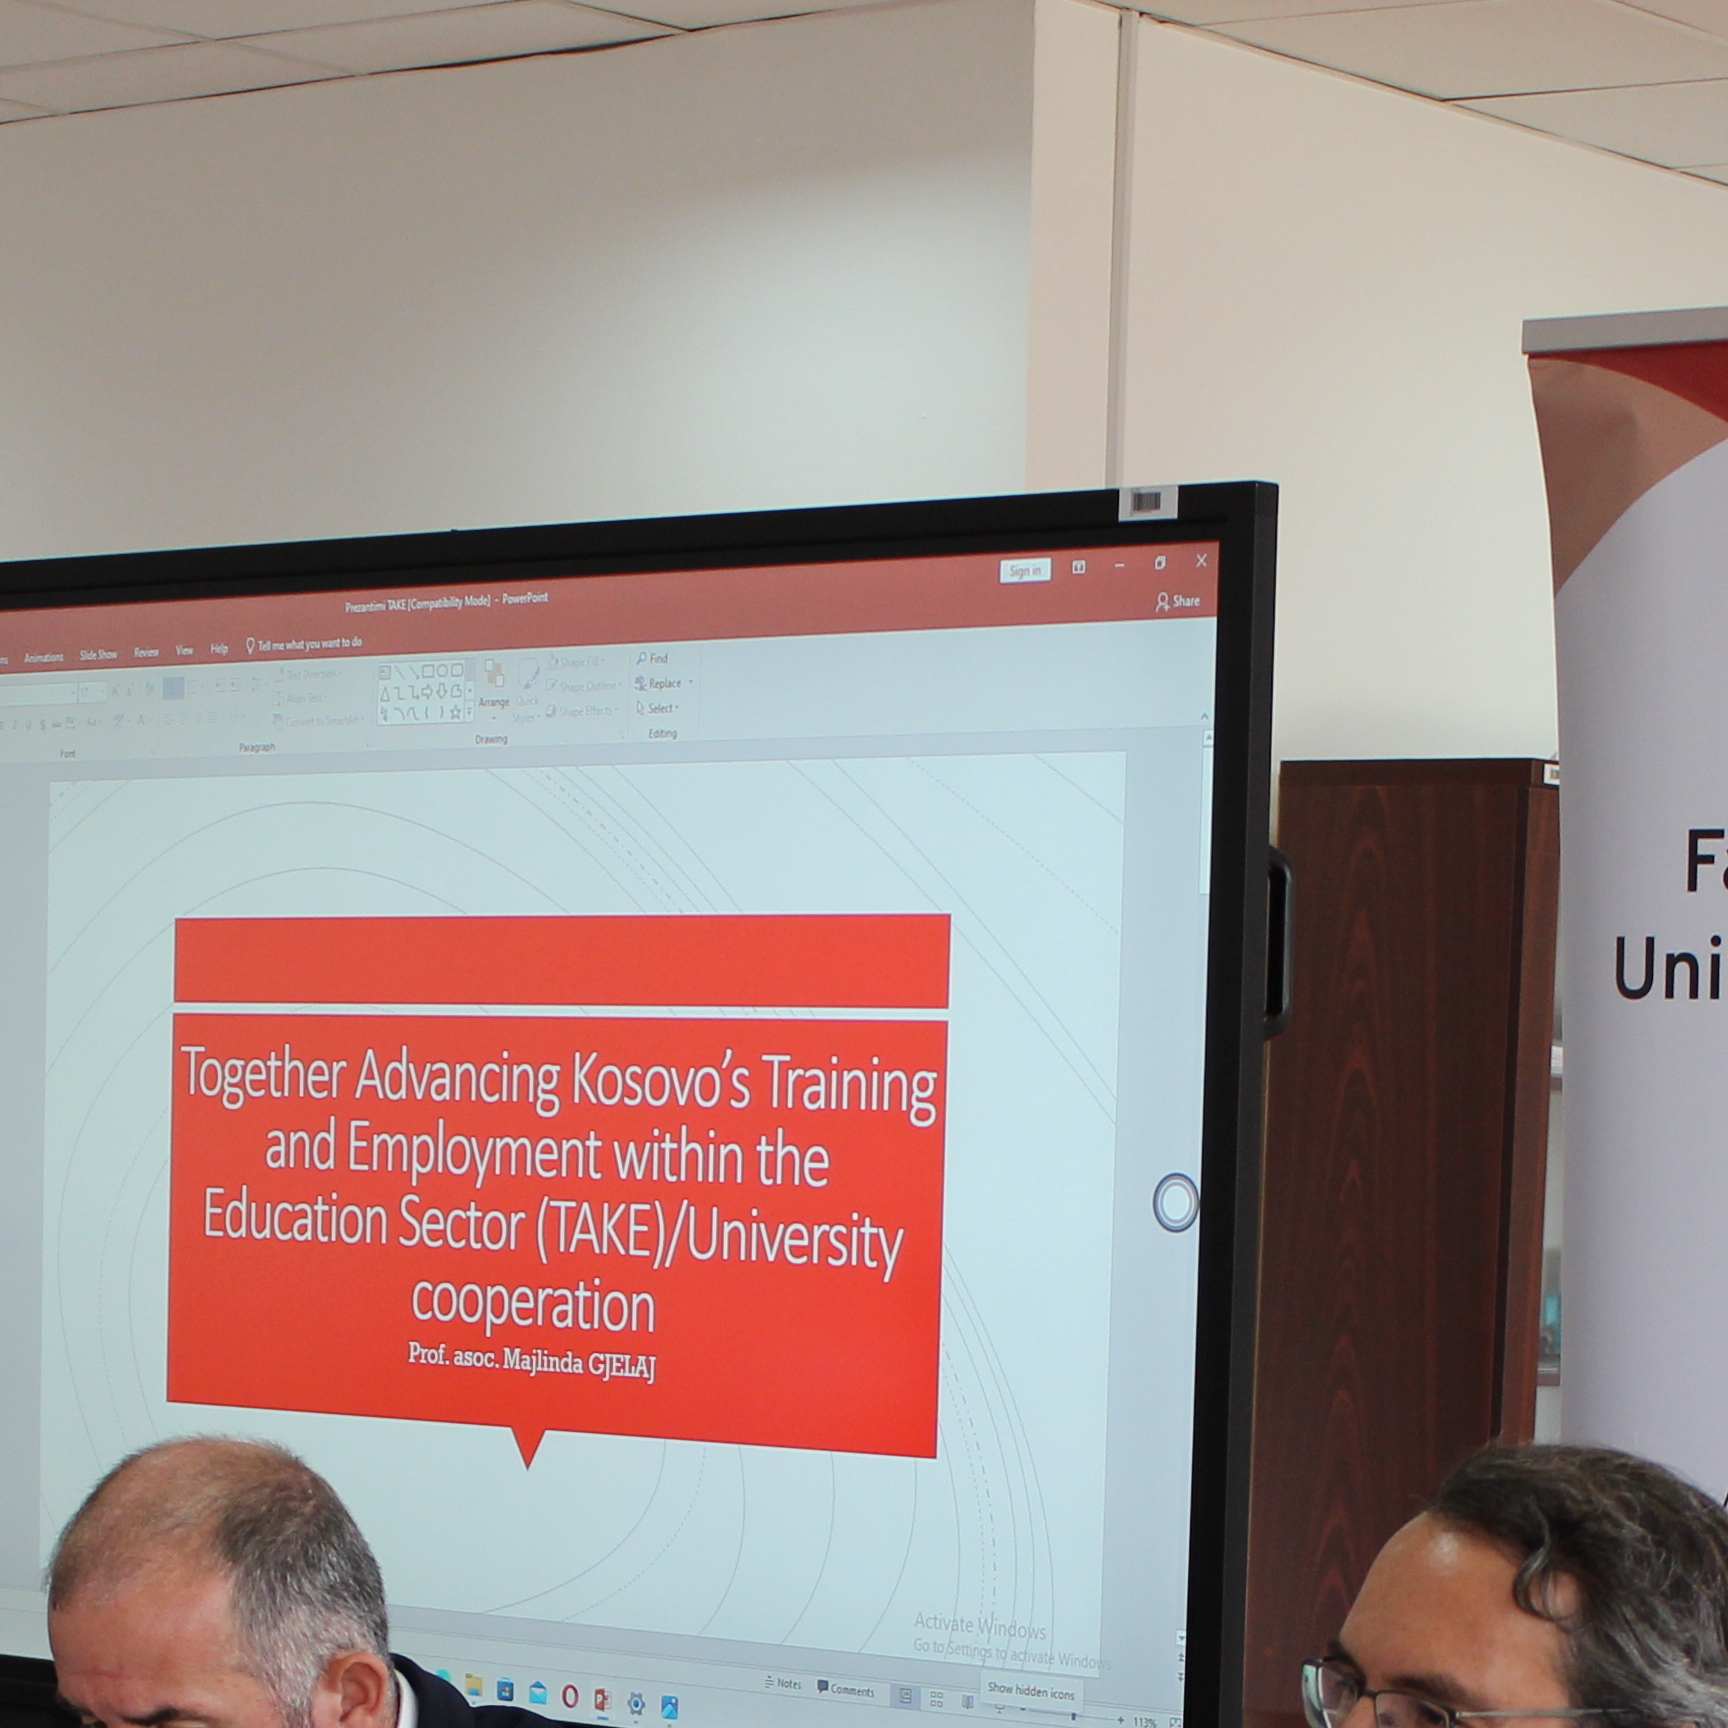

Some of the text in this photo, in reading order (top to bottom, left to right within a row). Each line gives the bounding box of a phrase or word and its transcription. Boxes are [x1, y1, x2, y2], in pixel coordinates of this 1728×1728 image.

[1009, 564, 1041, 580] Sign in
[345, 602, 386, 613] Prezantimi
[388, 599, 406, 611] TAKE
[407, 597, 463, 612] [Compatibility
[464, 595, 491, 608] Mode]
[502, 592, 549, 605] PowerPoint
[1172, 593, 1200, 608] Share
[24, 651, 64, 664] Animations
[80, 649, 97, 661] Slide
[98, 648, 118, 660] Show
[134, 647, 160, 659] Review
[175, 645, 195, 656] View
[210, 643, 229, 656] Help
[258, 640, 271, 651] Tell
[272, 642, 285, 651] me
[285, 639, 305, 650] what
[305, 640, 321, 652] you
[321, 638, 341, 649] want
[341, 637, 351, 647] to
[352, 636, 363, 647] do
[650, 653, 668, 664] Find
[648, 678, 682, 691] Replace
[478, 697, 510, 710] Arrange
[648, 703, 673, 715] Select
[475, 733, 508, 747] Drawing
[648, 728, 678, 741] Editing
[60, 749, 77, 760] Font
[239, 742, 276, 754] Paragraph
[180, 1043, 939, 1128] Together Advancing Kosovo’s Training
[264, 1115, 830, 1189] and Employment within the
[203, 1184, 905, 1283] Education Sector (TAKE)/University
[410, 1277, 657, 1339] cooperation
[407, 1341, 658, 1385] Prof. asoc. Majlinda GJELAJ
[914, 1610, 1047, 1641] Activate Windows
[913, 1637, 930, 1651] Go
[931, 1639, 945, 1654] to
[947, 1641, 993, 1662] Settings
[995, 1646, 1008, 1661] to
[1010, 1648, 1055, 1666] activate
[777, 1677, 802, 1690] Notes
[831, 1683, 875, 1698] Comments
[987, 1680, 1075, 1702] Show hidden icons
